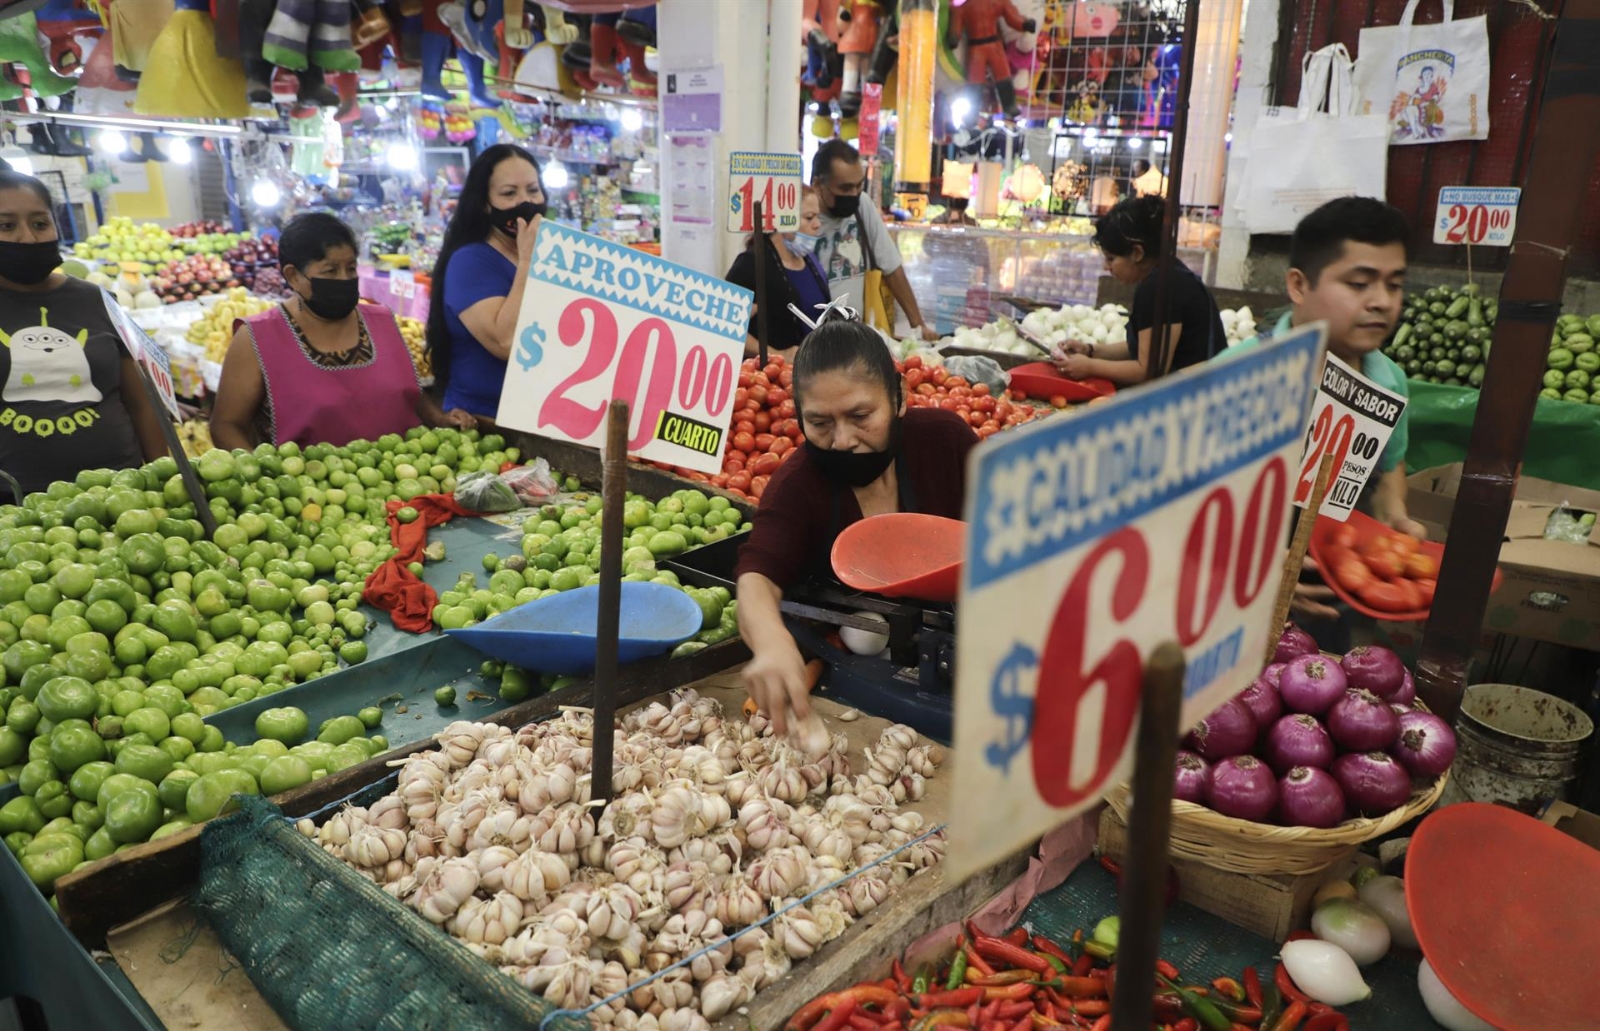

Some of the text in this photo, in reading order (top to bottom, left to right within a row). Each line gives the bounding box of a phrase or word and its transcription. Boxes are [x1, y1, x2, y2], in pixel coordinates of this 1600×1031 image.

[780, 215, 797, 226] KILO
[1489, 232, 1506, 241] KILO
[542, 243, 744, 327] APROVECHE
[1322, 366, 1399, 422] COLOR Y SABOR
[663, 416, 720, 455] CUARTO
[1342, 460, 1367, 476] PESOS
[1330, 479, 1359, 506] KILO
